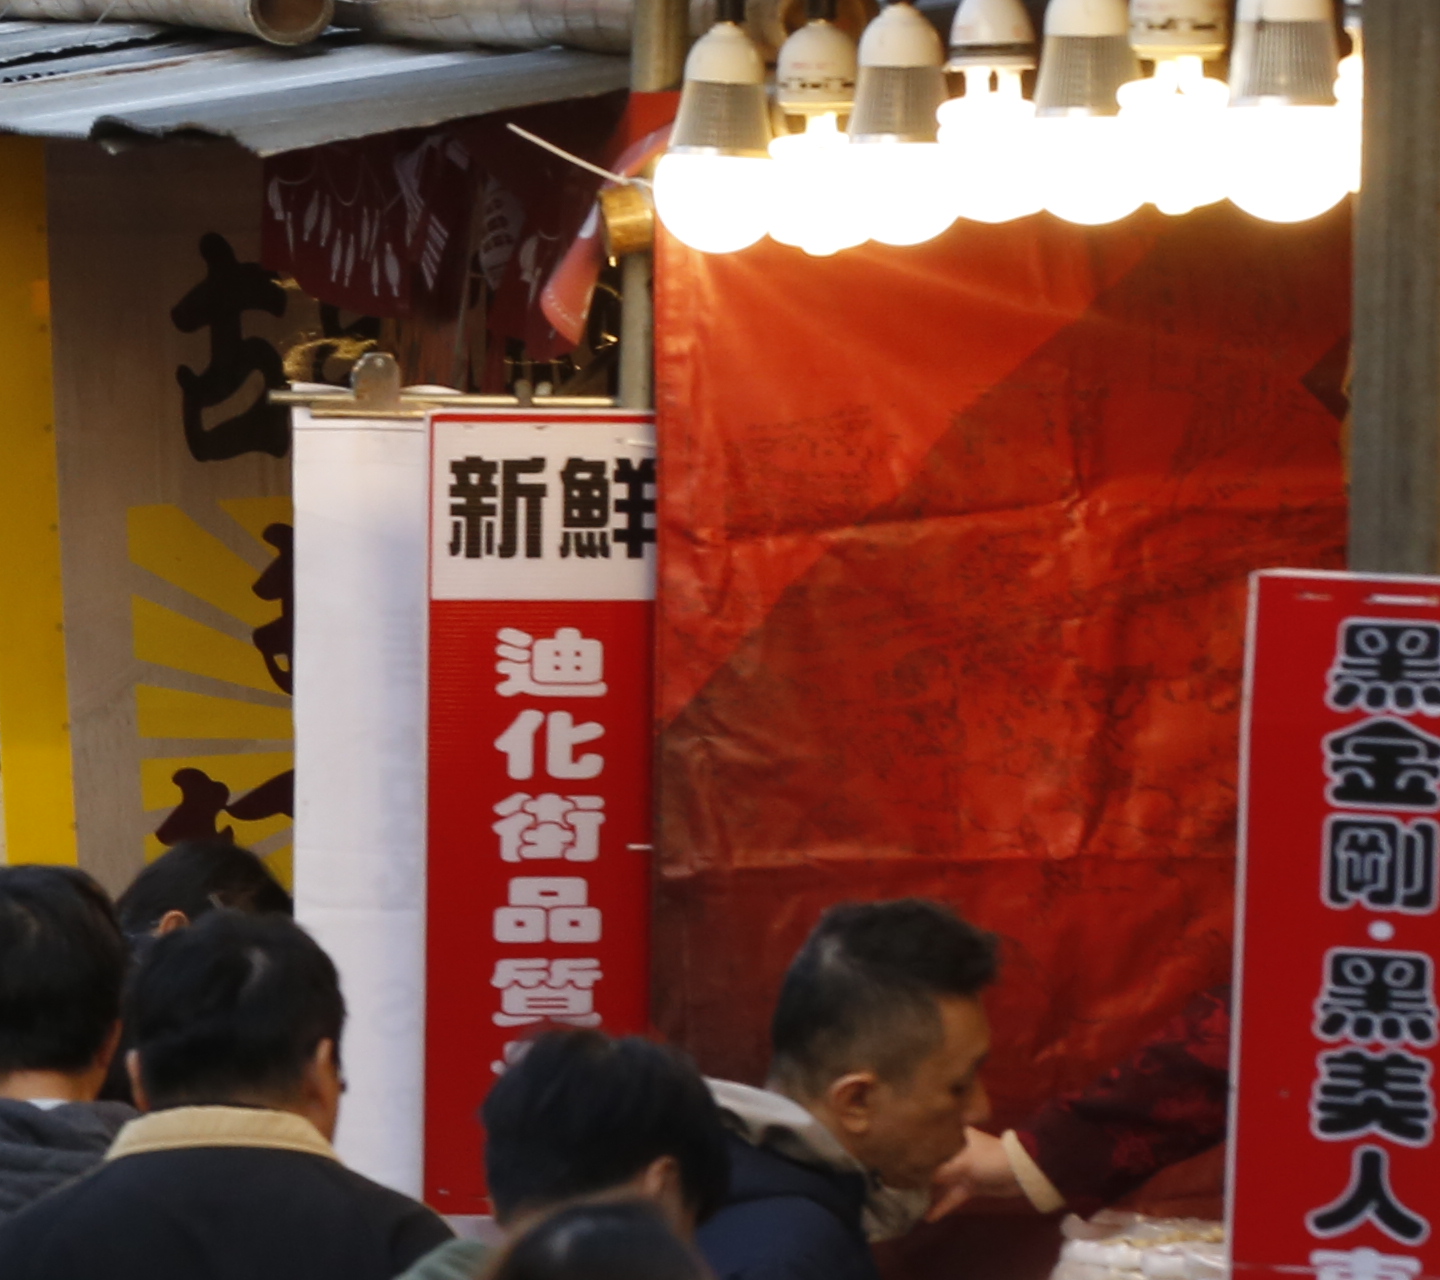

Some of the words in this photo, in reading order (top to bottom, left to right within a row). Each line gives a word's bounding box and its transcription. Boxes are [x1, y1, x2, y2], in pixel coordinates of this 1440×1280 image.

[447, 454, 658, 562] 新鮮
[491, 625, 608, 1034] 迪化街品質
